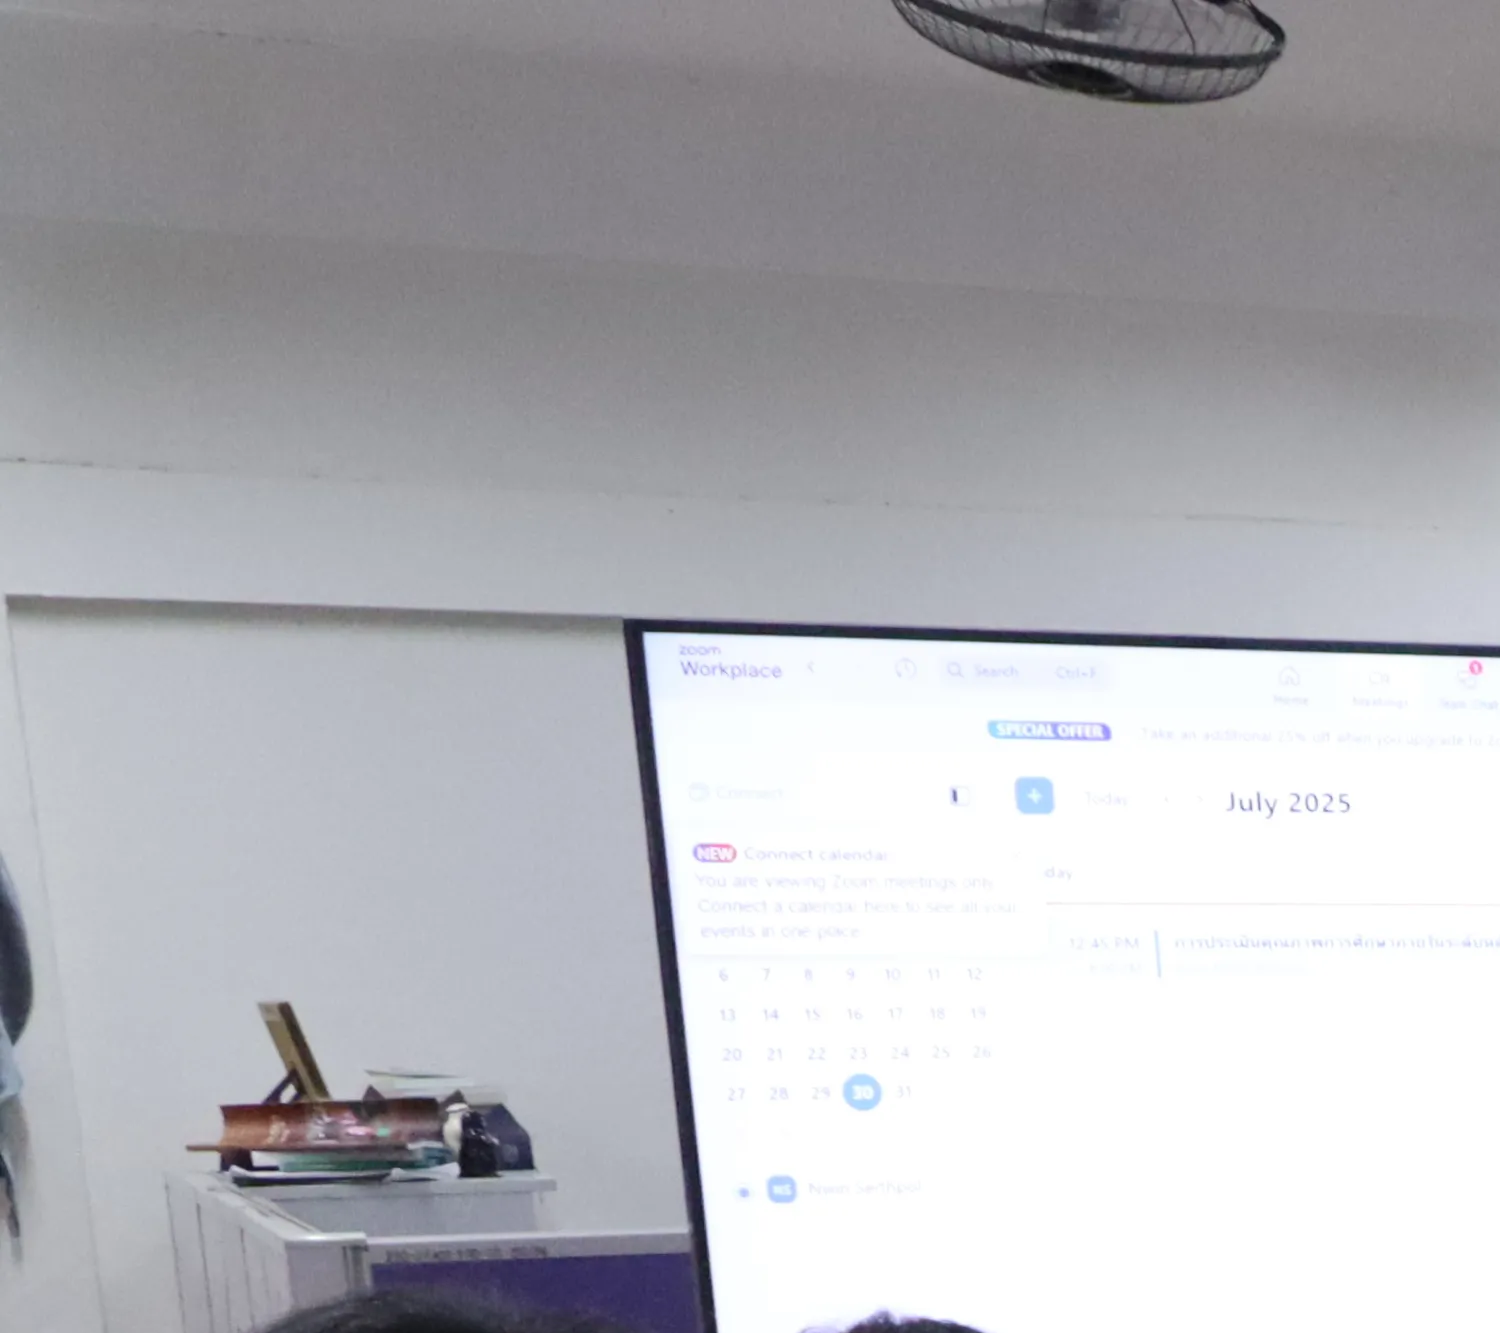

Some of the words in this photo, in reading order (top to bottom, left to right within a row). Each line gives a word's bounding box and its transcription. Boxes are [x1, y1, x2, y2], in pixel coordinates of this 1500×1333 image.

[678, 658, 783, 681] Workplace
[997, 722, 1053, 738] SPECIAL
[1058, 724, 1104, 739] OFFER
[1226, 791, 1278, 820] July
[1288, 792, 1351, 814] 2025
[697, 846, 733, 861] NEW
[742, 846, 814, 862] Connect
